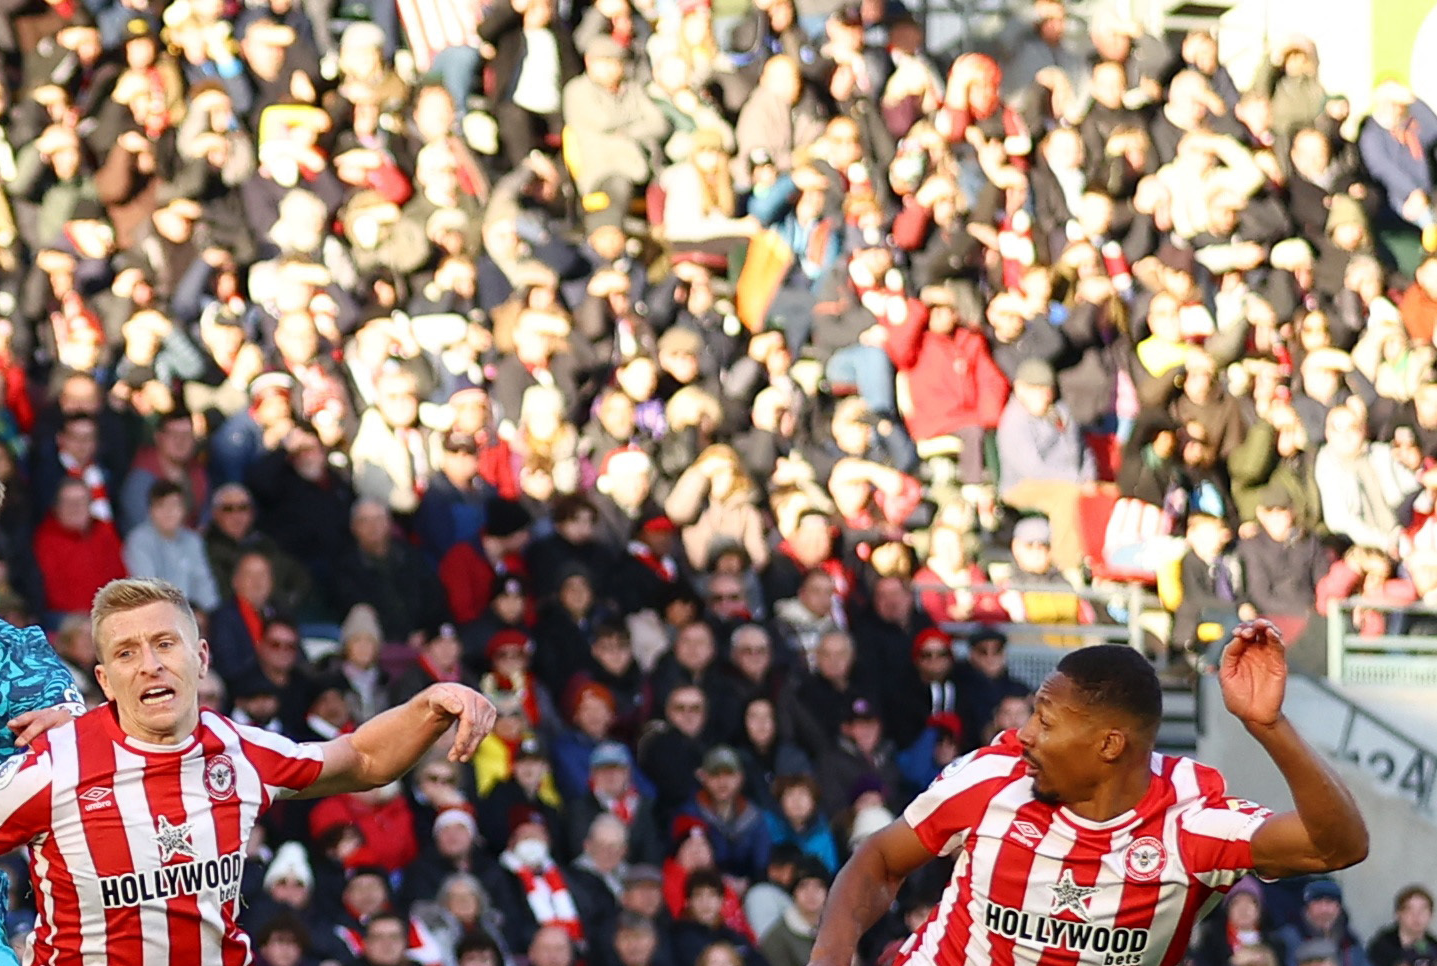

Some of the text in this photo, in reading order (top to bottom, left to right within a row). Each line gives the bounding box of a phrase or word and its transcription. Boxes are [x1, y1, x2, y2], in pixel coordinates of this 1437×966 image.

[100, 854, 241, 907] HOLLYWOOD
[219, 885, 238, 903] bets
[985, 902, 1148, 953] HOLLYWOOD
[1103, 952, 1141, 966] bets
